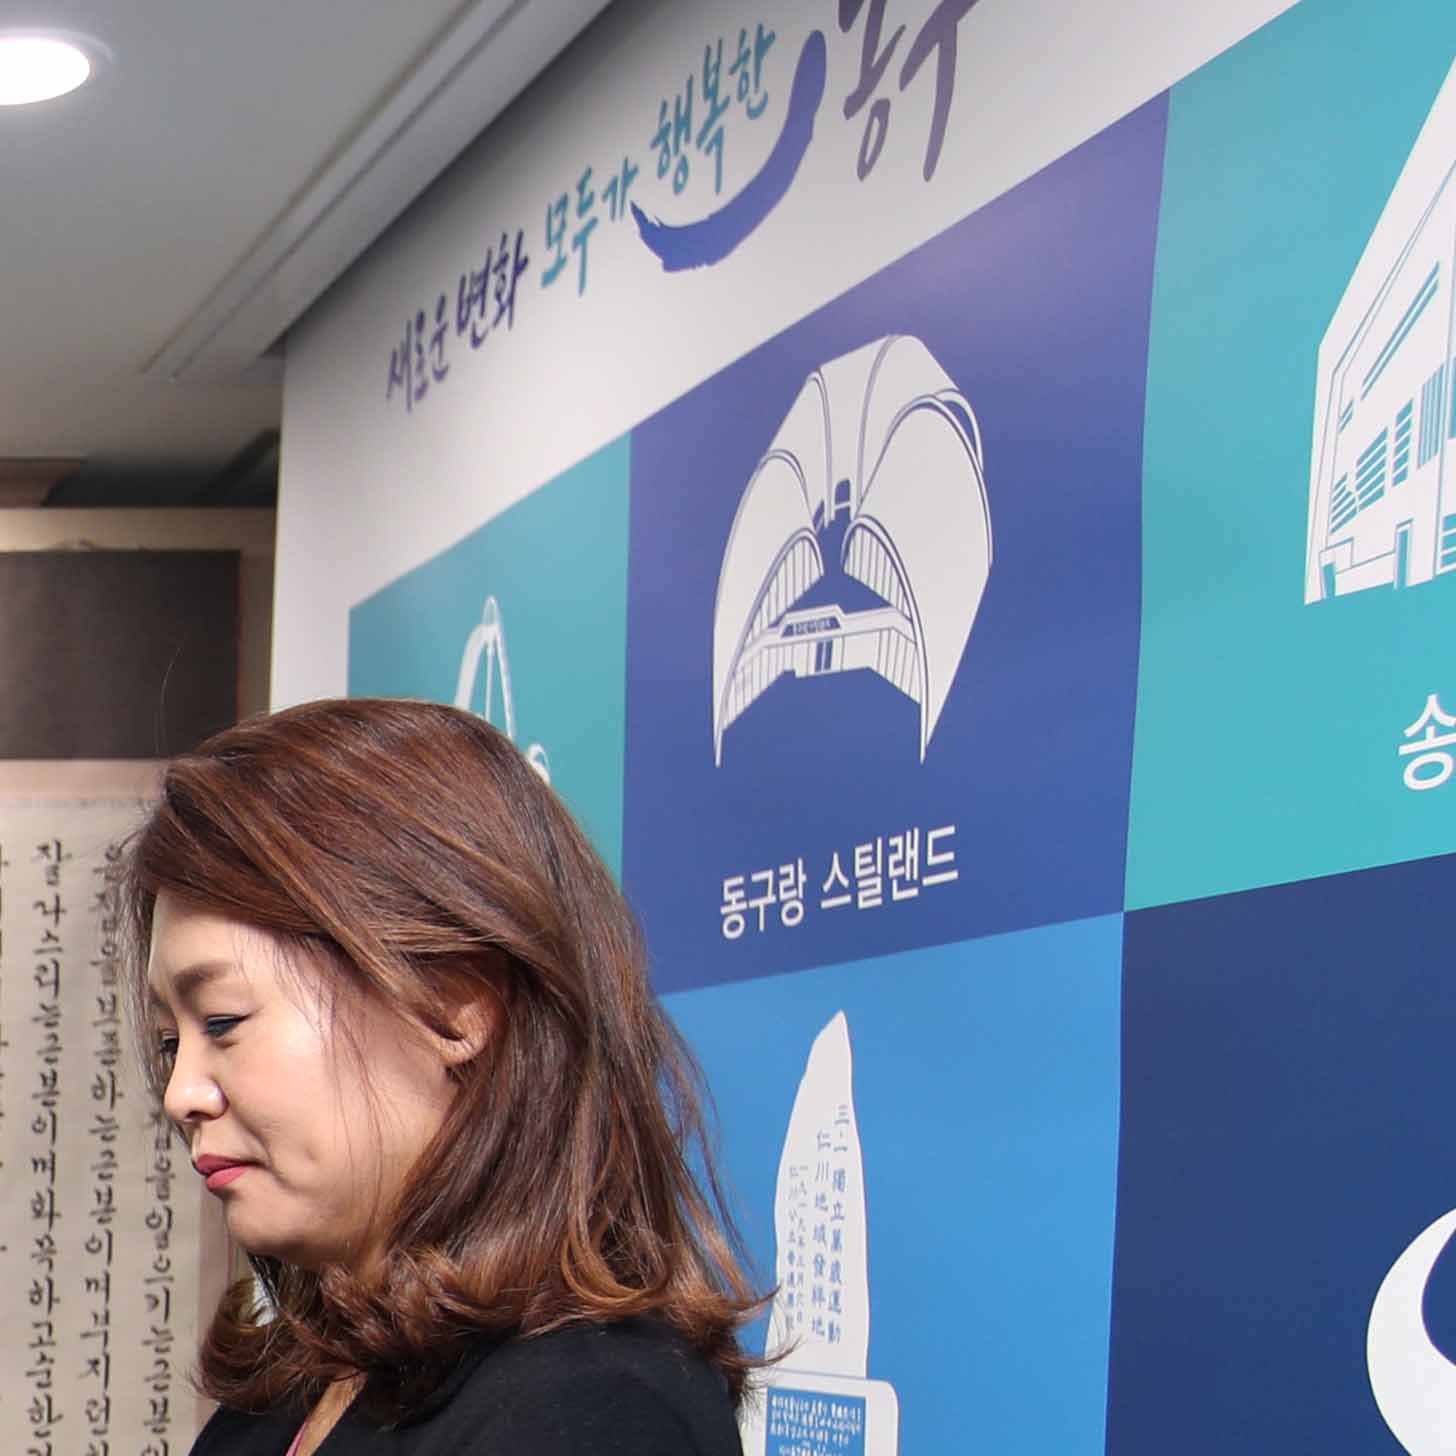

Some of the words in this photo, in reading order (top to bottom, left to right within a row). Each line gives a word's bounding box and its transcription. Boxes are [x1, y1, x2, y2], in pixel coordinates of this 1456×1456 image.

[387, 294, 449, 413] 새로운
[456, 229, 529, 350] 변화
[540, 157, 639, 297] 모두가
[650, 22, 776, 196] 행복한
[720, 857, 807, 940] 동구랑
[820, 824, 959, 910] 스틸랜드
